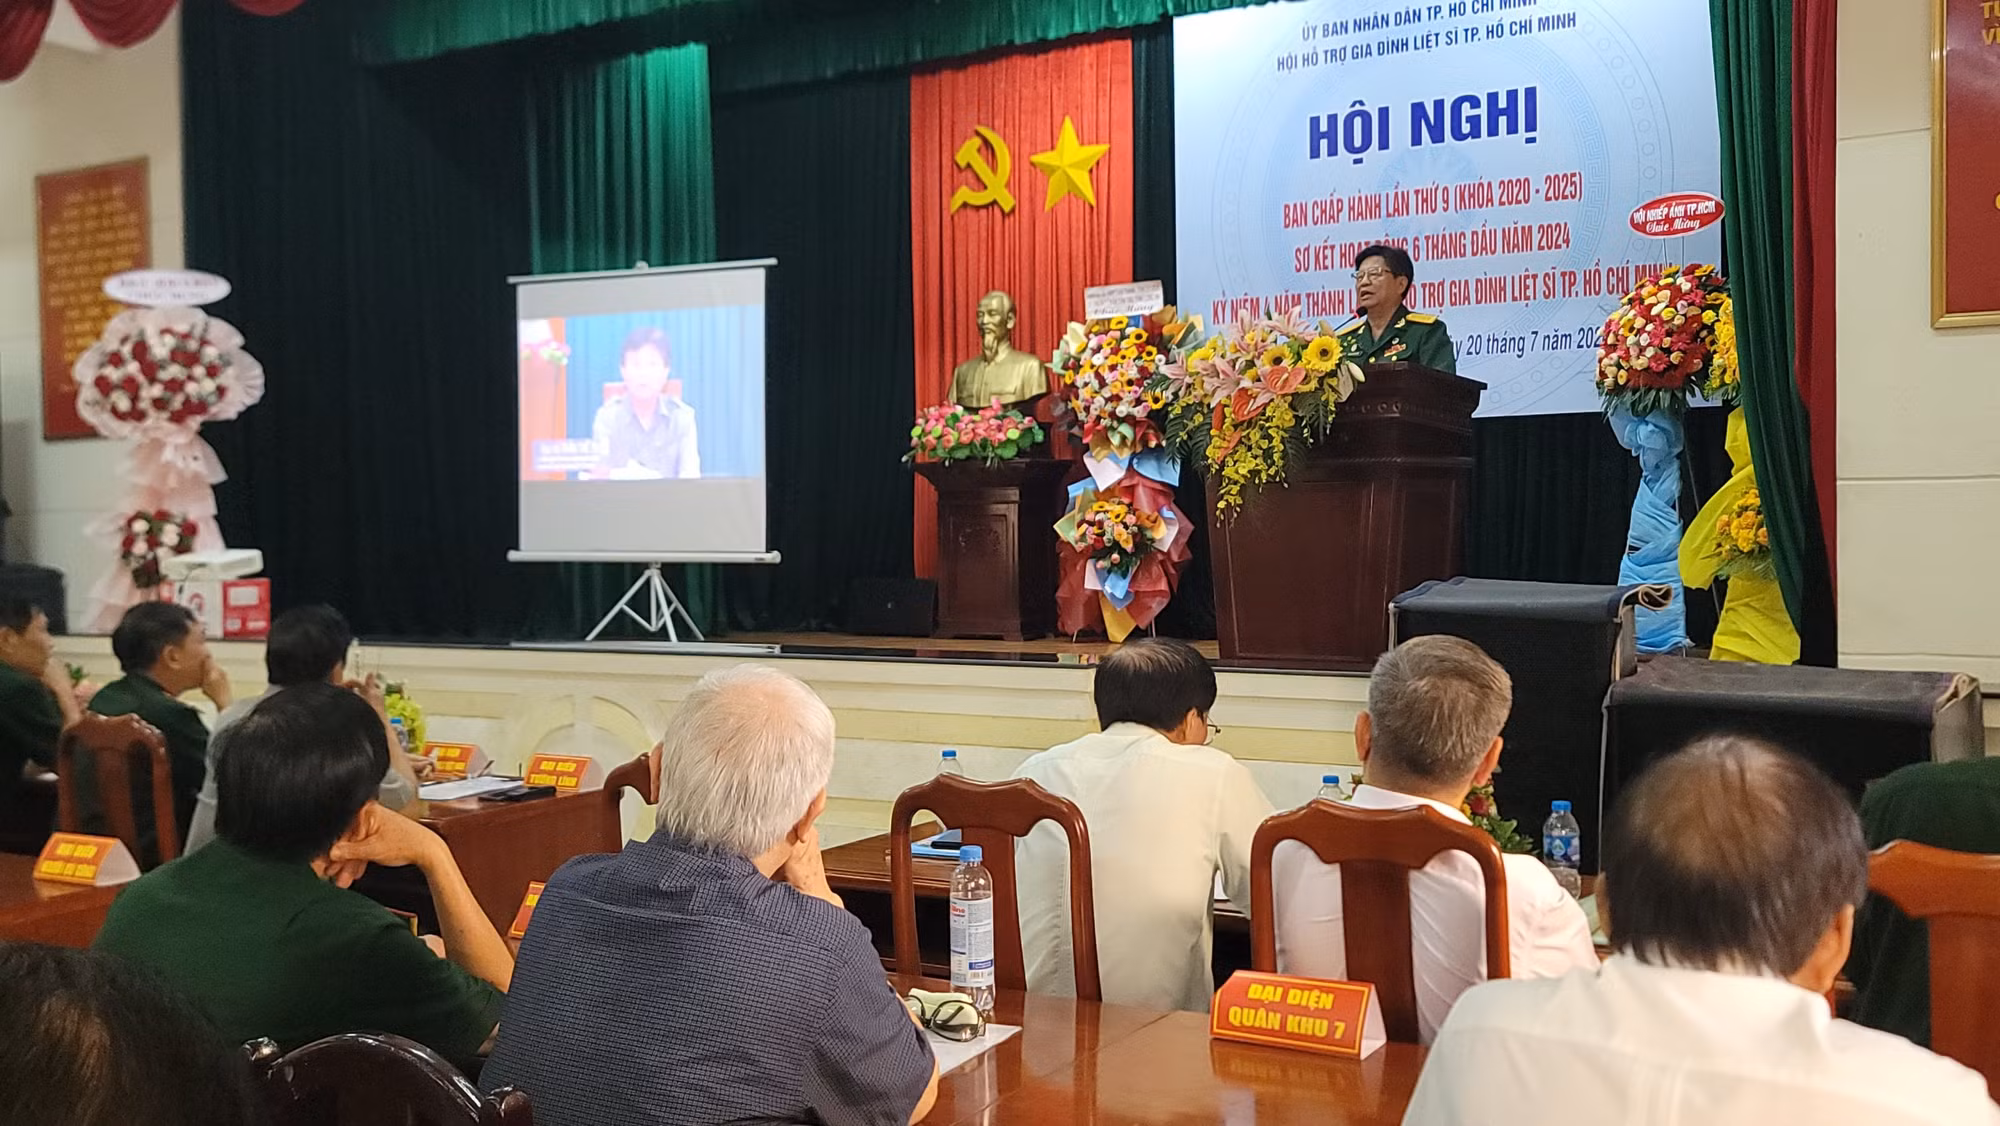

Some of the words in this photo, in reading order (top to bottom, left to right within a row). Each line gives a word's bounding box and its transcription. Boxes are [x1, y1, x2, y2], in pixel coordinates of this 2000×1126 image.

[1277, 51, 1298, 74] HỘI
[1323, 45, 1347, 66] TRỢ
[1351, 43, 1372, 60] GIA
[1377, 36, 1409, 56] ĐÌNH
[1413, 30, 1440, 52] LIỆT
[1463, 26, 1481, 43] TP.
[1509, 14, 1532, 36] CHÍ
[1537, 12, 1576, 33] MINH
[1322, 20, 1348, 38] BAN
[1353, 11, 1389, 33] NHÂN
[1394, 6, 1421, 27] DÂN
[1427, 5, 1444, 21] TP.
[1309, 99, 1390, 165] HỘI
[1410, 85, 1537, 147] NGHỊ
[1283, 201, 1308, 229] BAN
[1312, 187, 1344, 226] CHẤP
[1348, 188, 1382, 223] HÀNH
[1414, 181, 1440, 216] THỨ
[1442, 186, 1449, 213] 9
[1454, 176, 1494, 214] (KHÓA
[1498, 177, 1531, 207] 2020
[1544, 171, 1583, 202] 2025)
[1687, 200, 1716, 216] TP.HCM
[1295, 243, 1311, 273] SƠ
[1314, 235, 1336, 271] KẾT
[1412, 237, 1420, 262] 6
[1424, 227, 1466, 261] THÁNG
[1502, 220, 1533, 254] NĂM
[1537, 221, 1571, 252] 2024
[1306, 285, 1345, 318] THÀNH
[1421, 278, 1445, 313] TRỢ
[1450, 279, 1471, 307] GIA
[1475, 272, 1507, 305] ĐÌNH
[1511, 267, 1538, 307] LIỆT
[1543, 266, 1556, 300] SĨ
[1560, 271, 1579, 298] TP.
[1607, 260, 1630, 295] CHÍ
[1466, 334, 1483, 356] 20
[1487, 331, 1526, 359] tháng
[1531, 331, 1539, 352] 7
[1543, 328, 1572, 351] năm
[1577, 326, 1604, 349] 202
[1248, 983, 1283, 1004] ĐẠI
[1287, 988, 1334, 1011] DIỆN
[1228, 1006, 1281, 1030] QUÂN
[1286, 1014, 1328, 1037] KHU
[1334, 1022, 1345, 1040] 7
